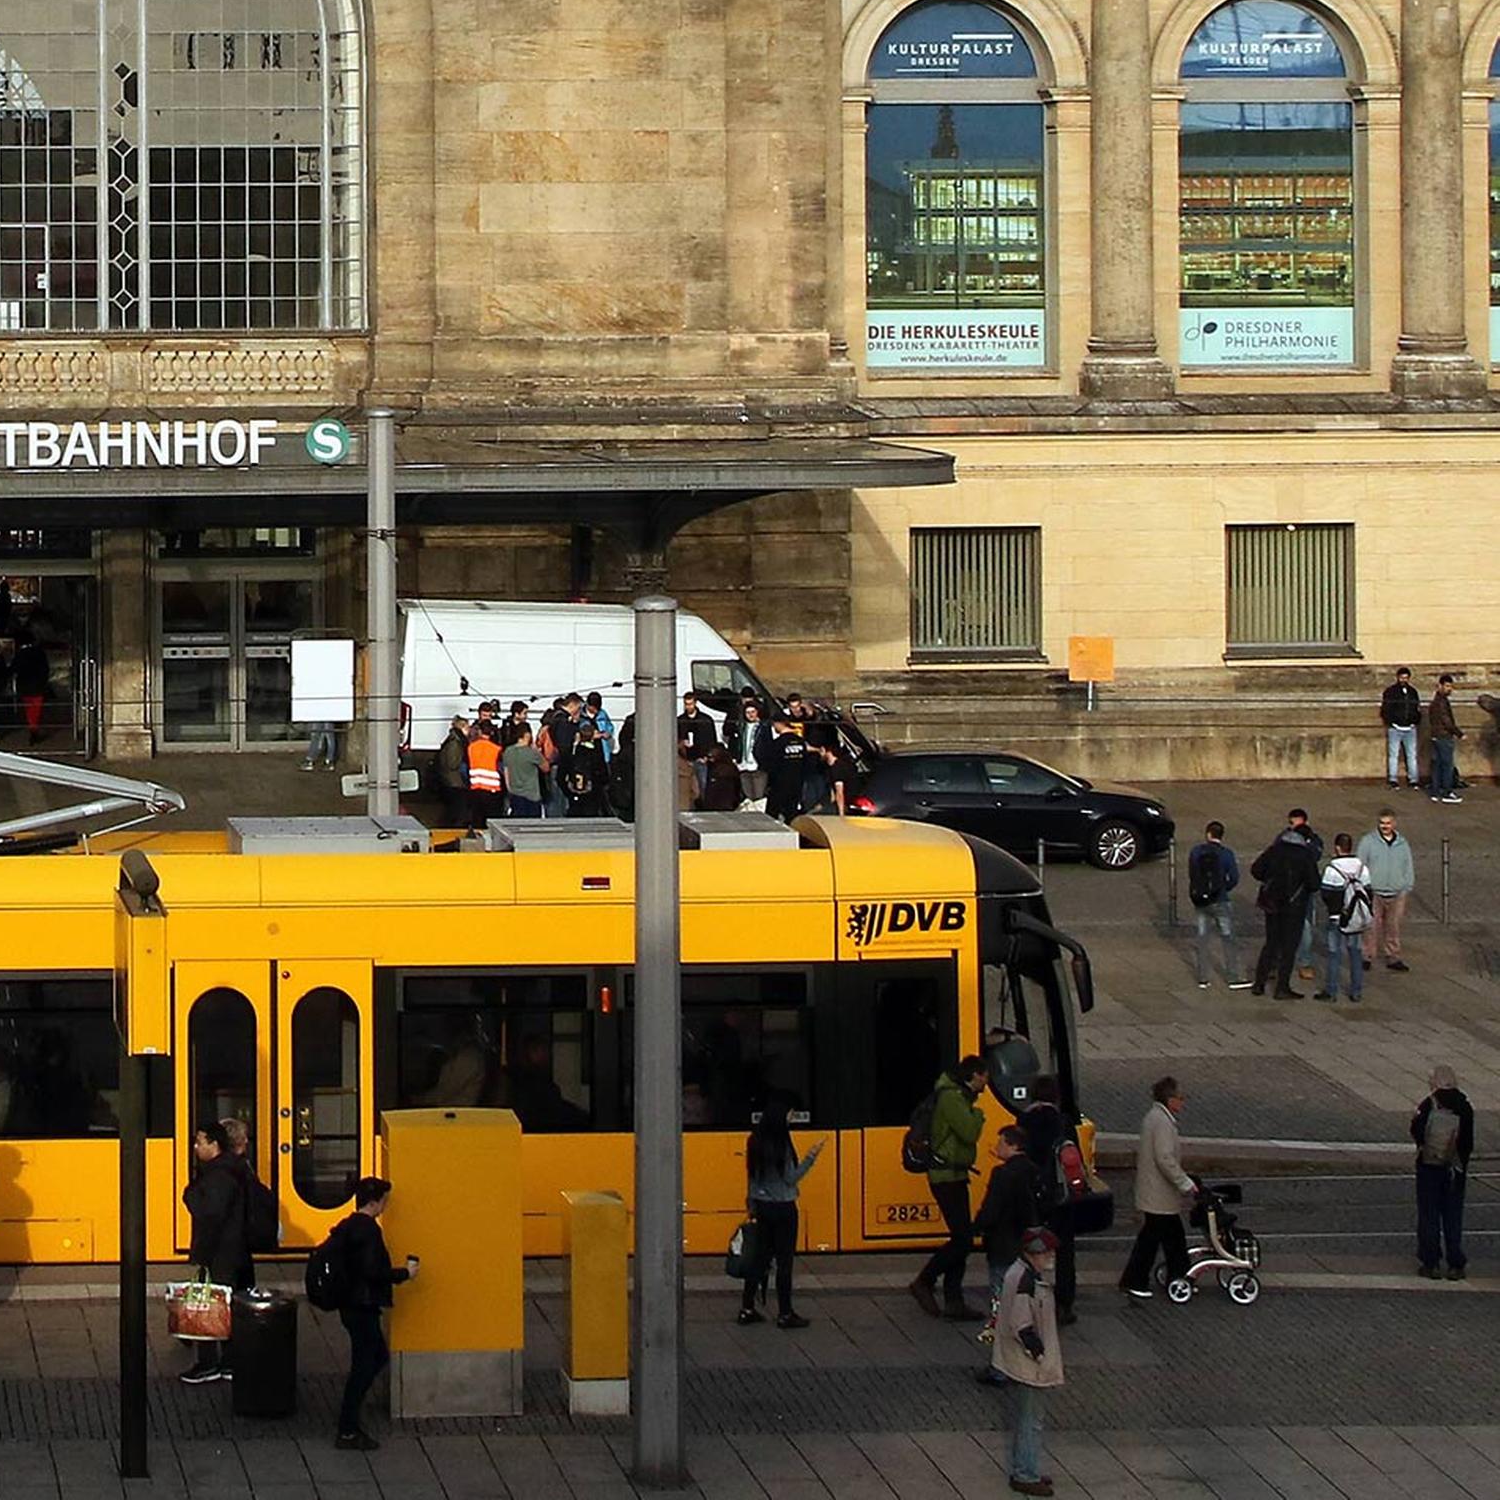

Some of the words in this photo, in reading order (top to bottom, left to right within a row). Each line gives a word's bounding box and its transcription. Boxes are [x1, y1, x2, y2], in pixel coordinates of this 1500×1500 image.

[888, 43, 1014, 55] KULTURPALAST
[1200, 42, 1323, 54] KULTURPALAST
[910, 57, 960, 66] DRESDEN
[1221, 56, 1269, 65] DRESDEN
[868, 325, 896, 339] DIE
[901, 324, 1039, 339] HERKULESKEULE
[1225, 321, 1303, 334] DRESDNER
[868, 341, 925, 351] DRESDENS
[930, 340, 1039, 350] KABARETT-THEATER
[1225, 335, 1338, 348] PHILHARMONIE
[900, 353, 1008, 363] www.herkuleskeule.de
[311, 422, 346, 460] S
[887, 901, 967, 932] DVB
[887, 1205, 930, 1221] 2824
